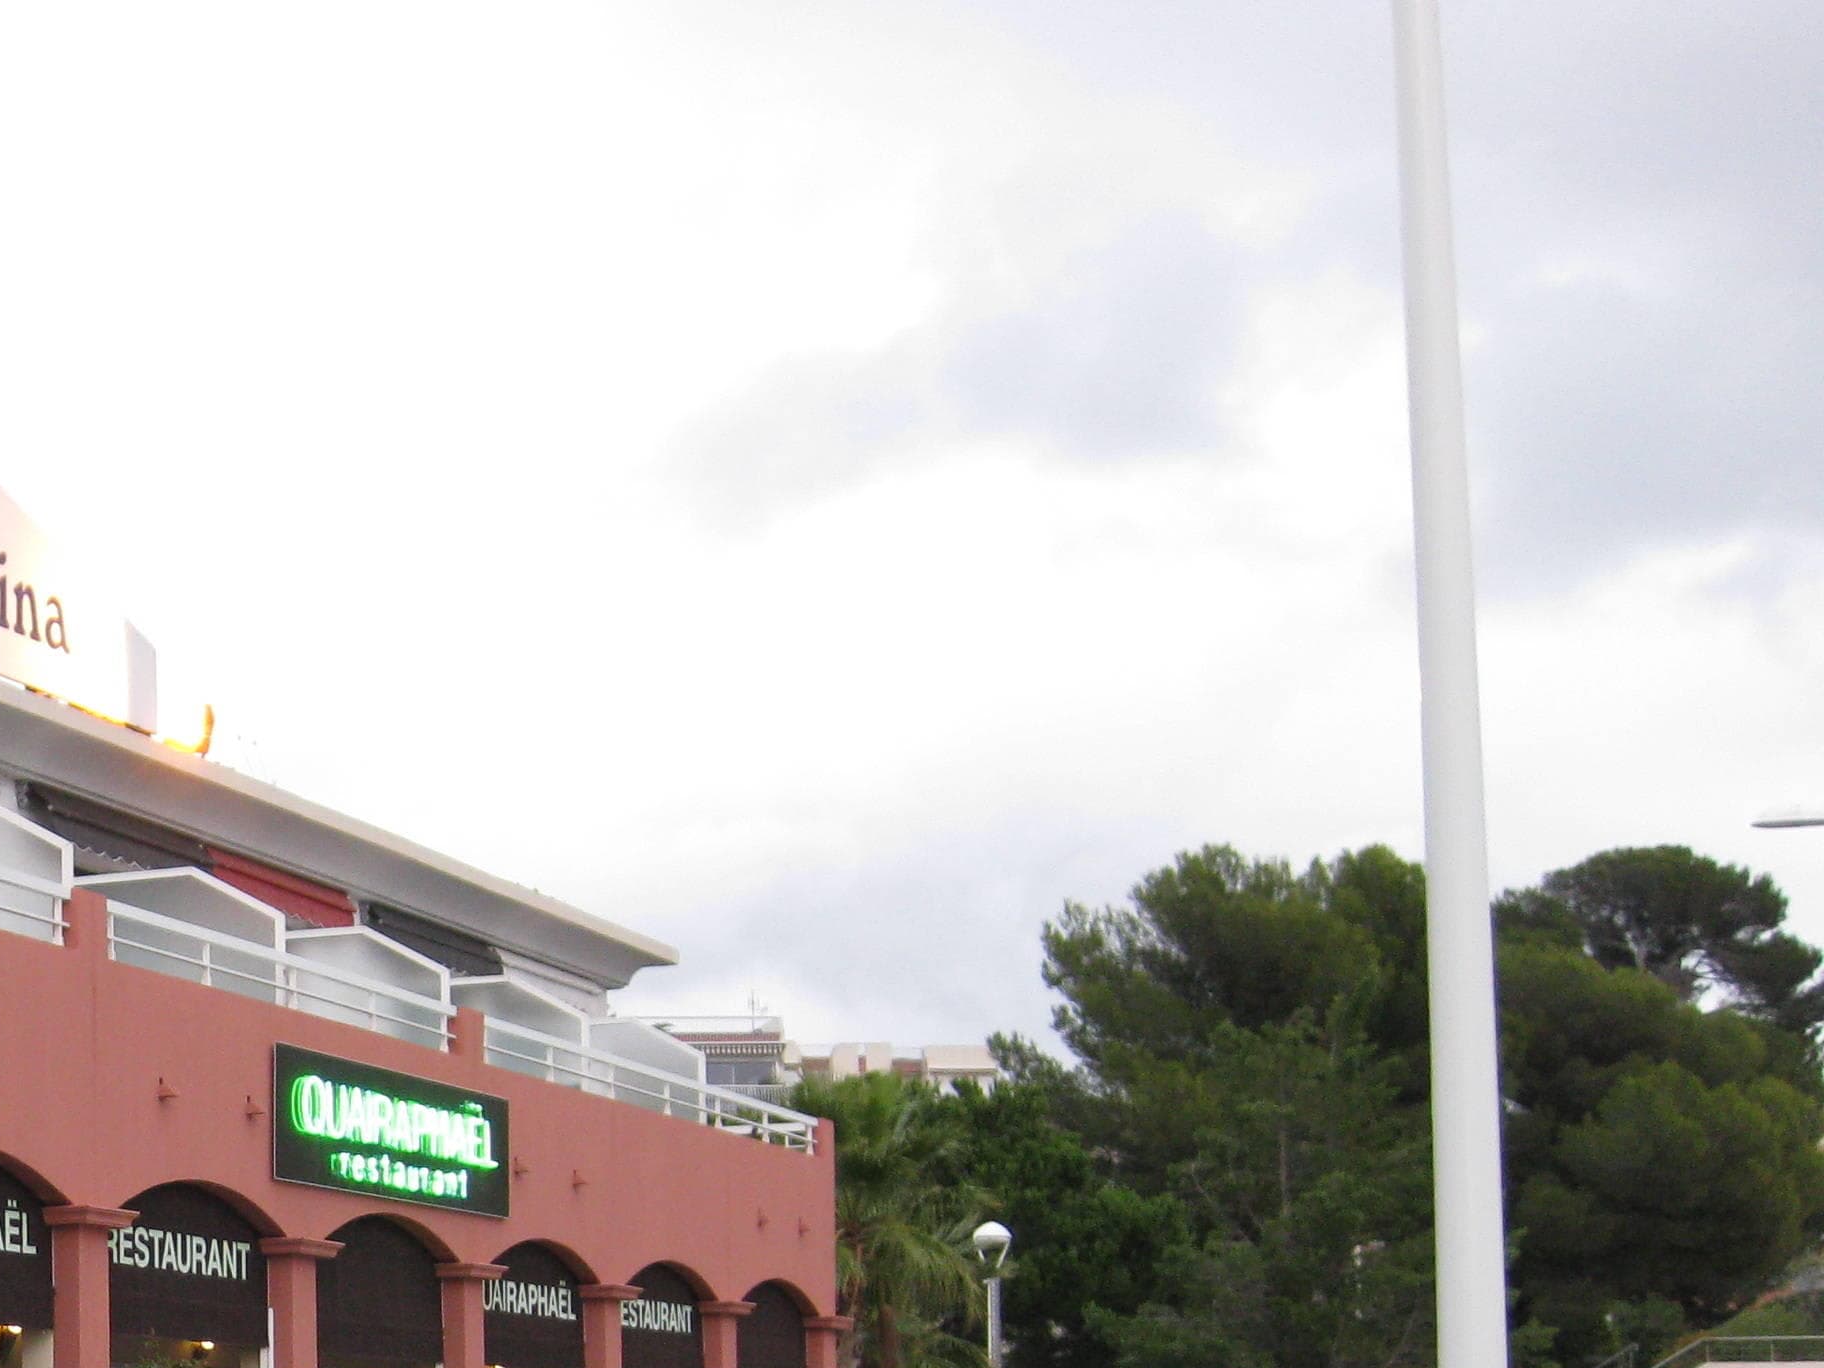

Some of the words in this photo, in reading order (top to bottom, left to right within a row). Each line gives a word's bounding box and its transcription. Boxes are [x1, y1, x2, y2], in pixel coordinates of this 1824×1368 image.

[330, 1151, 468, 1199] restaurant
[107, 1226, 251, 1281] RESTAURANT
[481, 1279, 577, 1321] UAIRAPHAËL
[620, 1299, 693, 1334] ESTAURANT
